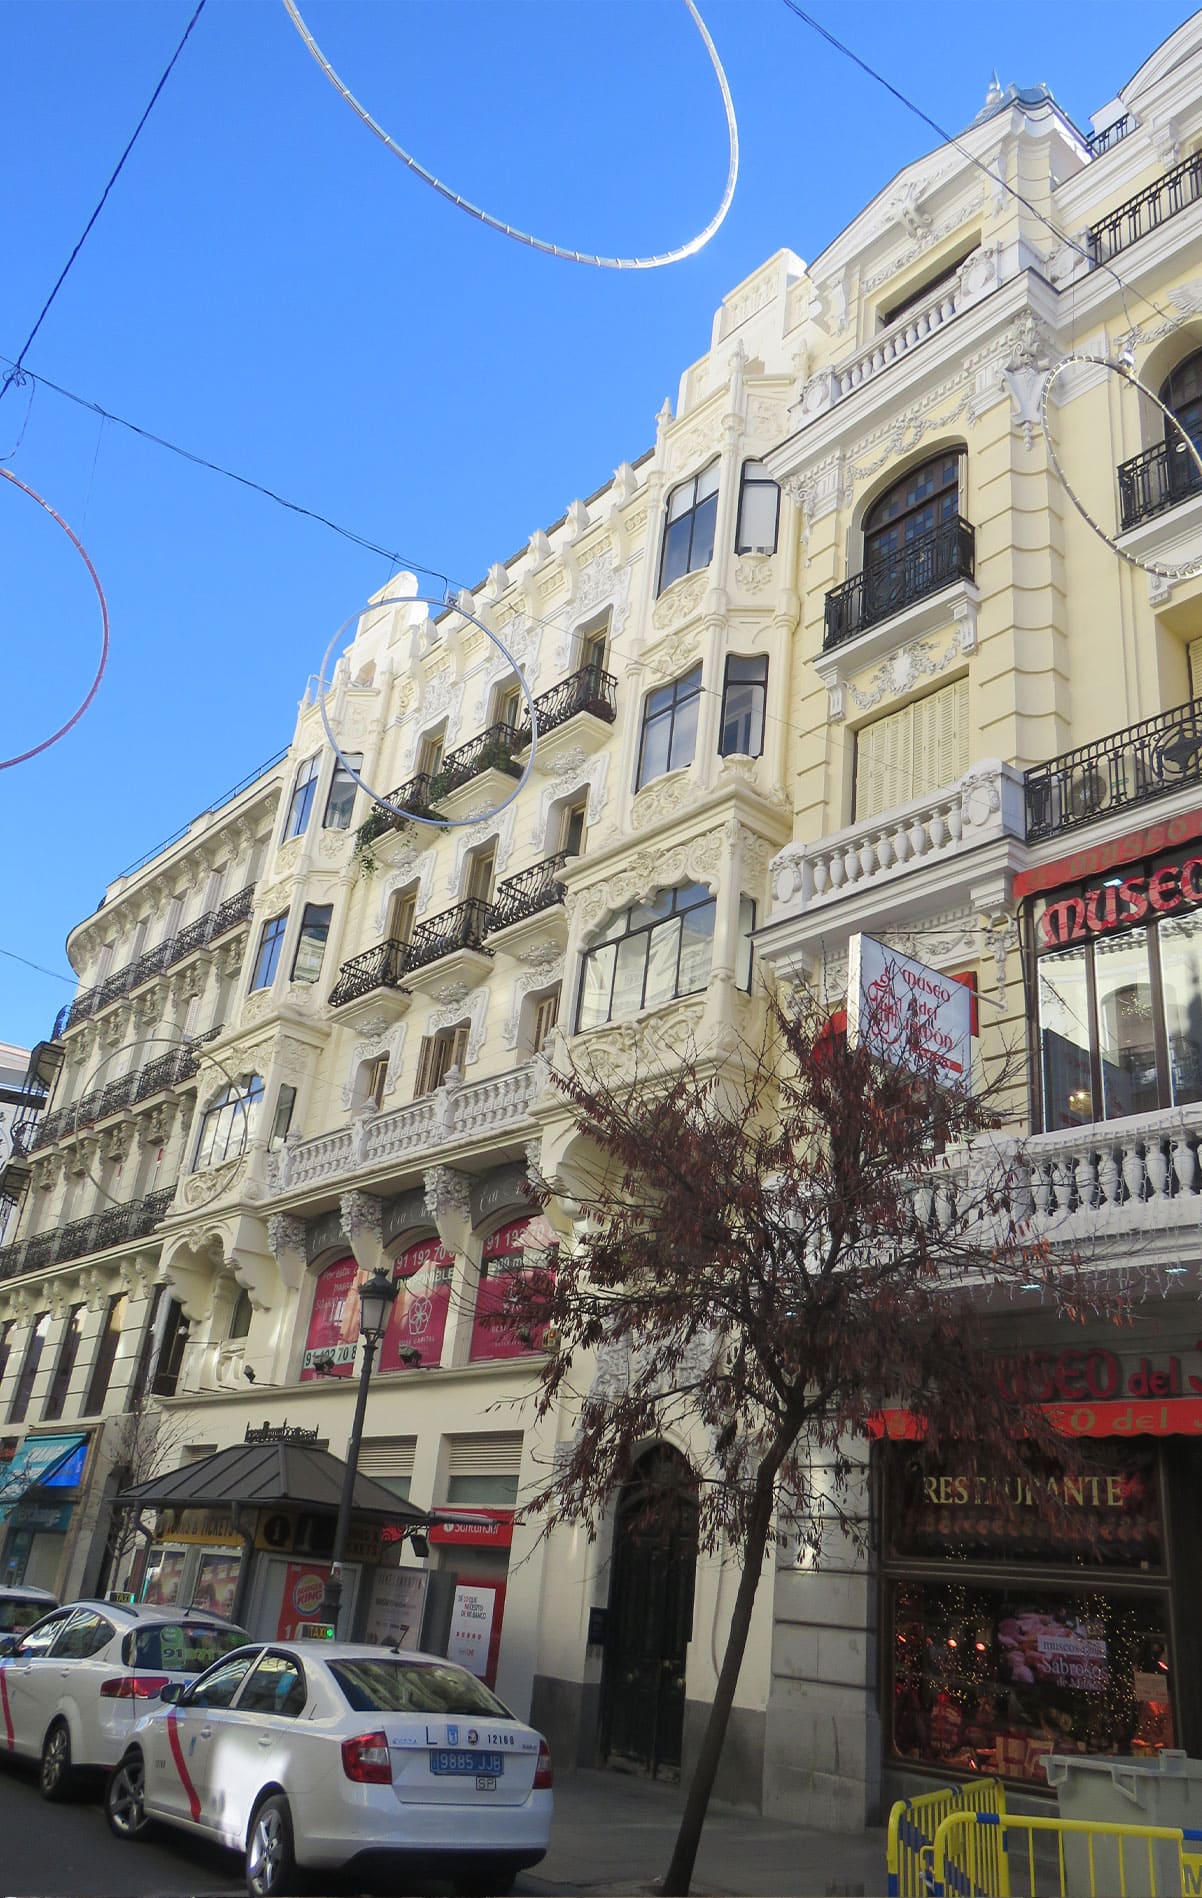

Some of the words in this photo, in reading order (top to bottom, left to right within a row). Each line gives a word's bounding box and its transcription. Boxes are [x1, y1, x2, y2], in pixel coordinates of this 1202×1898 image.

[396, 1253, 409, 1269] 91
[413, 1248, 431, 1266] 192
[338, 1346, 349, 1361] 70
[1128, 1355, 1179, 1396] del
[1112, 1406, 1168, 1432] del
[297, 1590, 323, 1605] KING
[163, 1648, 183, 1658] 91
[426, 1726, 438, 1745] L
[477, 1778, 494, 1790] SP
